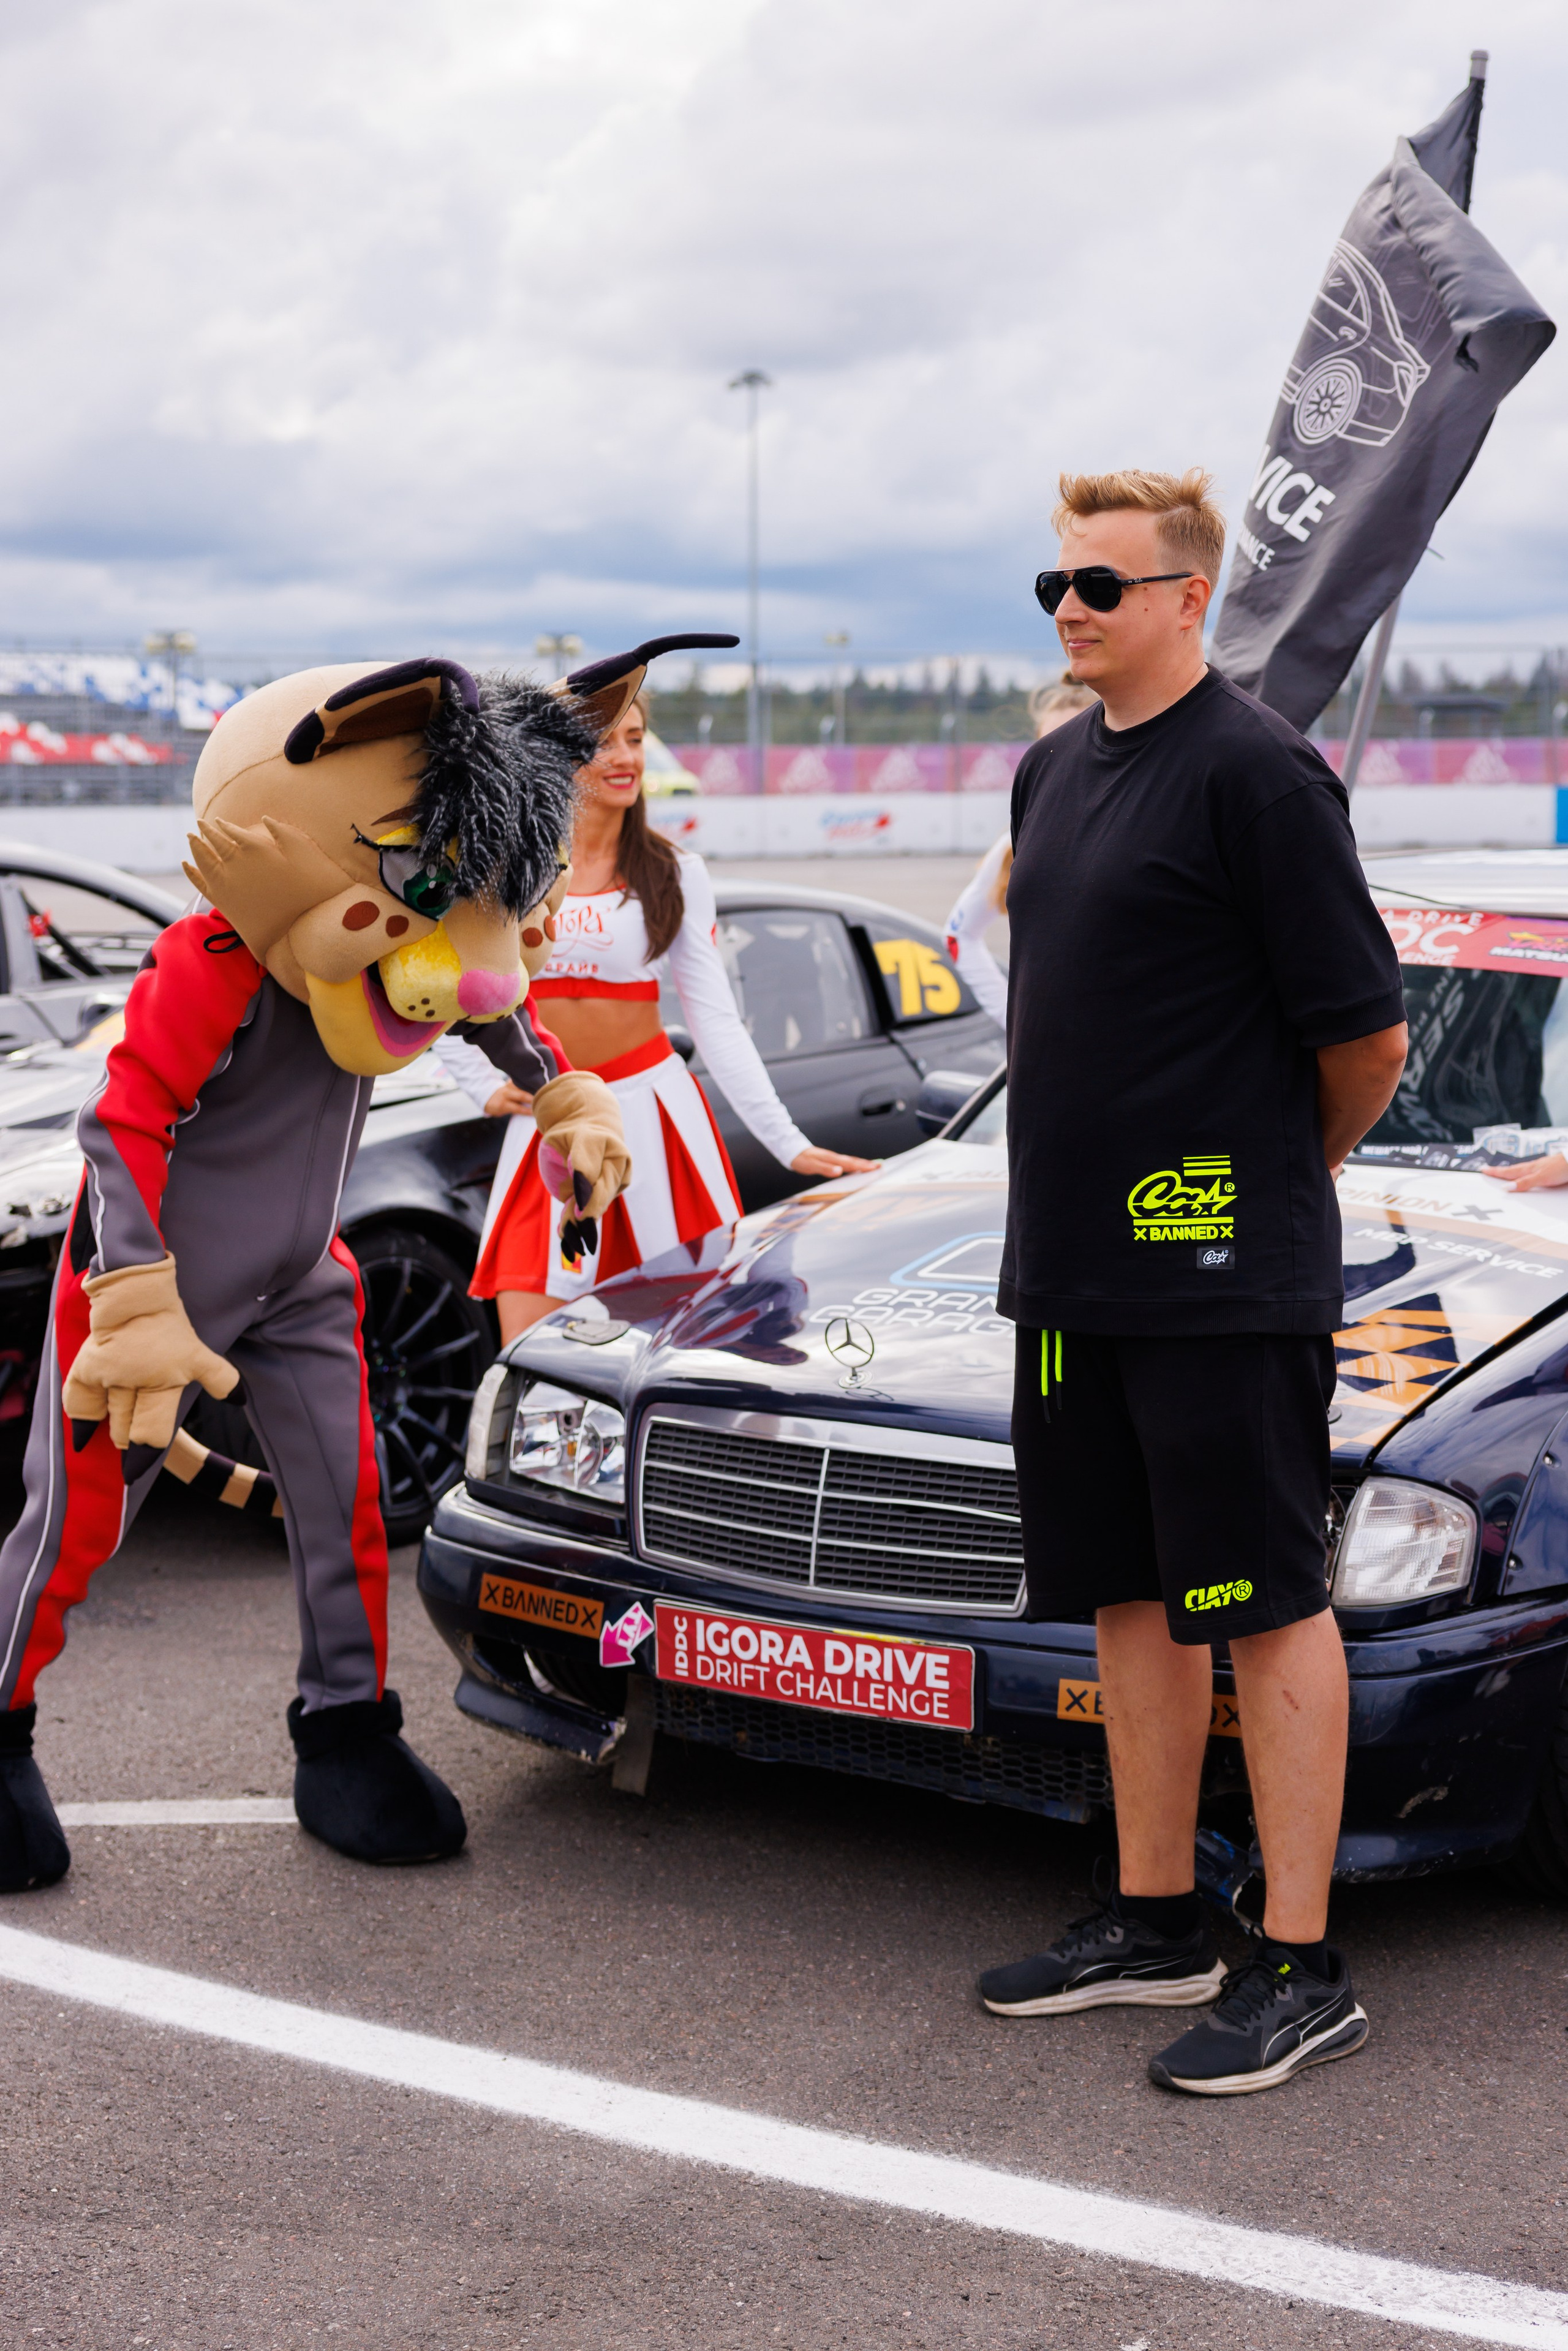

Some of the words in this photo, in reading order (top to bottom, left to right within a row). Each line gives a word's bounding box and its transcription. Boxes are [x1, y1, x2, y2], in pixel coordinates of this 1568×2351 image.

[1249, 443, 1336, 543] VICE
[1382, 920, 1474, 956] DC
[872, 938, 962, 1016] 75
[1427, 1240, 1565, 1279] SERVICE
[809, 1305, 1016, 1338] GARAG
[852, 1288, 999, 1313] GRAN
[501, 1586, 579, 1625] BANNED
[674, 1615, 689, 1677] IDDC
[696, 1618, 814, 1671] IGORA
[824, 1639, 950, 1690] DRIVE
[696, 1655, 771, 1691] DRIFT
[776, 1670, 950, 1719] CHALLENGE
